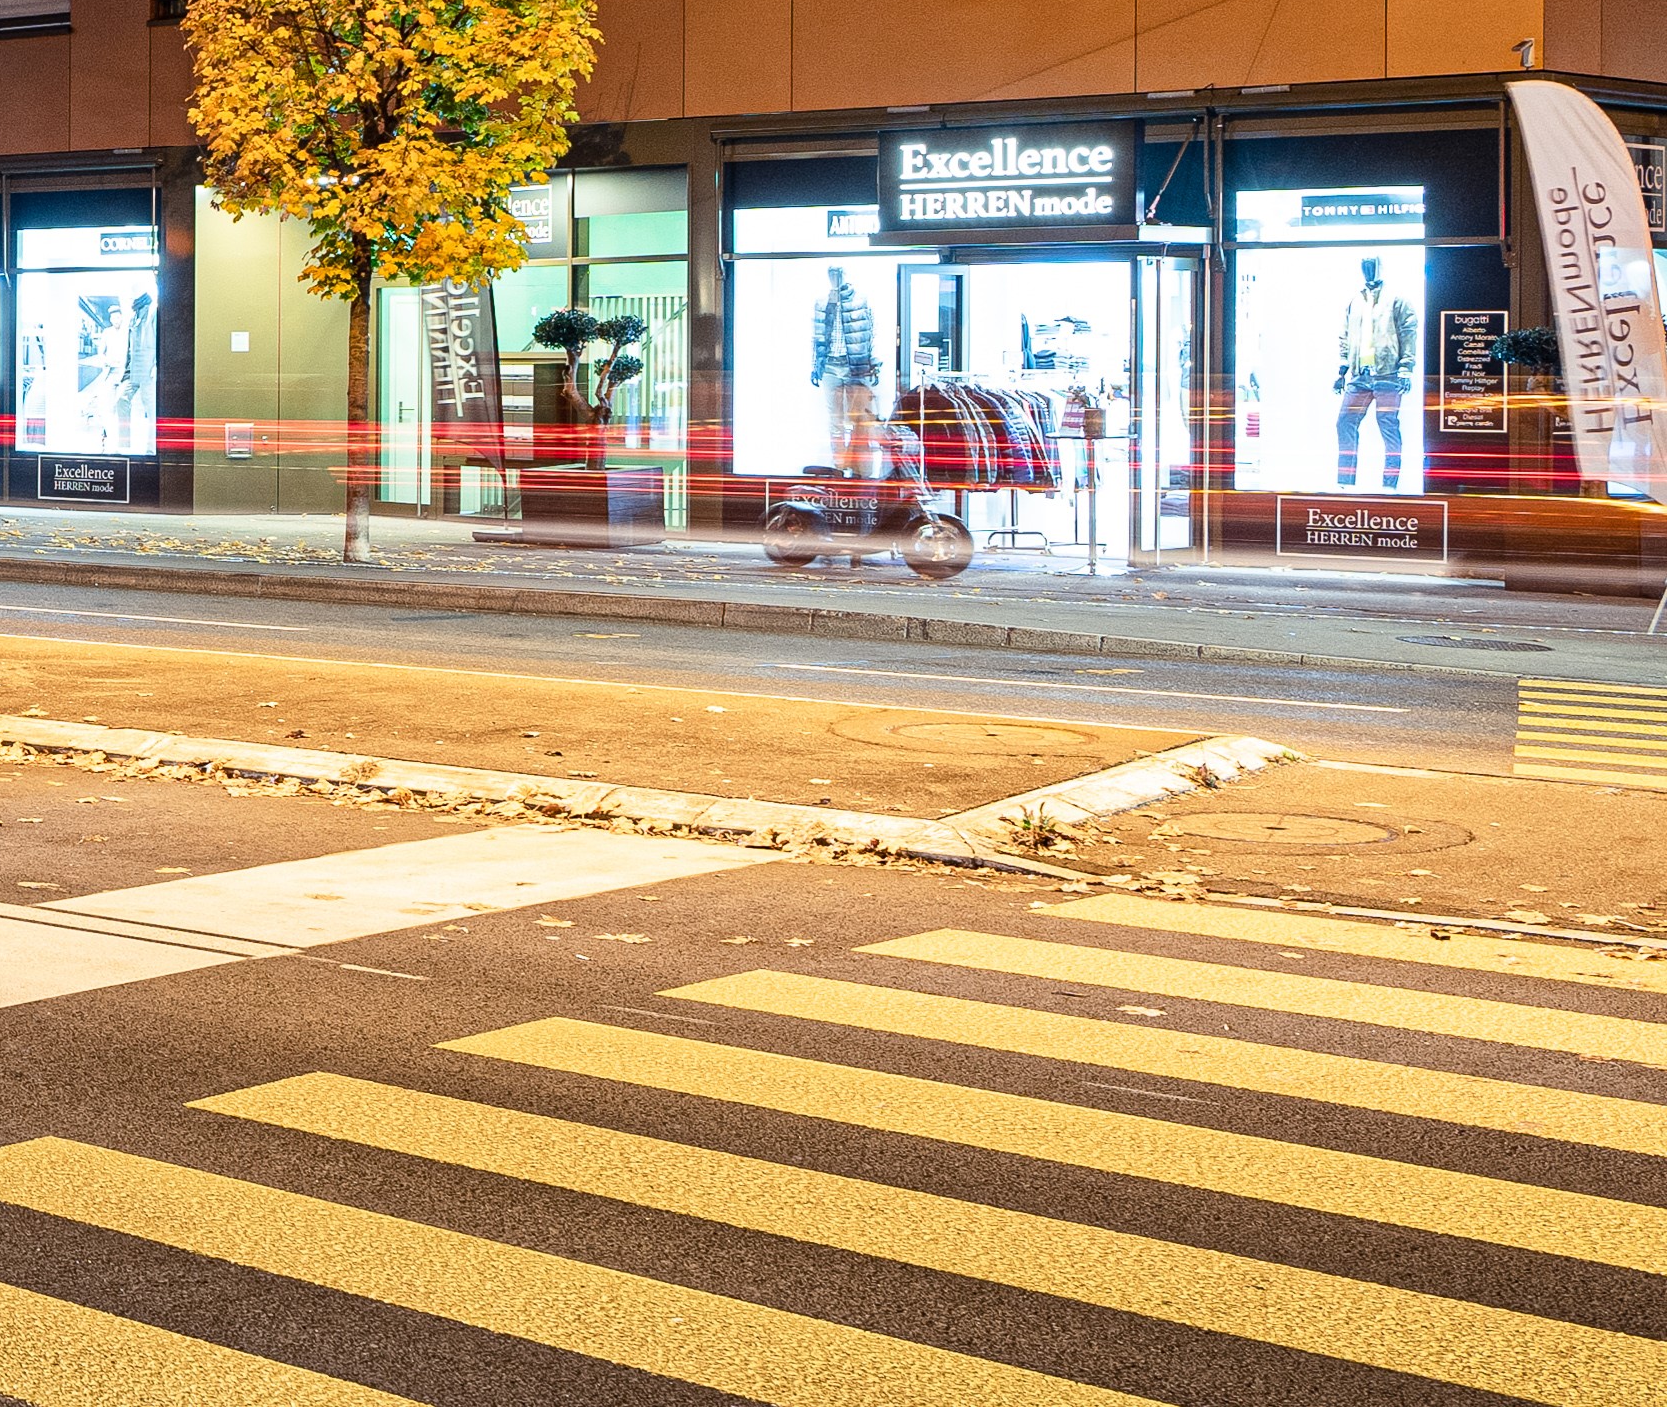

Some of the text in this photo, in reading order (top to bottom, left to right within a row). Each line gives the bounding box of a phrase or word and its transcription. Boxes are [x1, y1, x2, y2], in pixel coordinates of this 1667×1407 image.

[900, 138, 1113, 179] Excellence
[900, 188, 1113, 220] HERREN mode
[1303, 205, 1357, 216] TOMMY
[1454, 315, 1489, 326] bugatti
[54, 464, 114, 480] Excellence
[54, 480, 114, 493] HERREN mode
[1306, 508, 1419, 531] Excellence
[1306, 530, 1418, 549] HERREN mode
